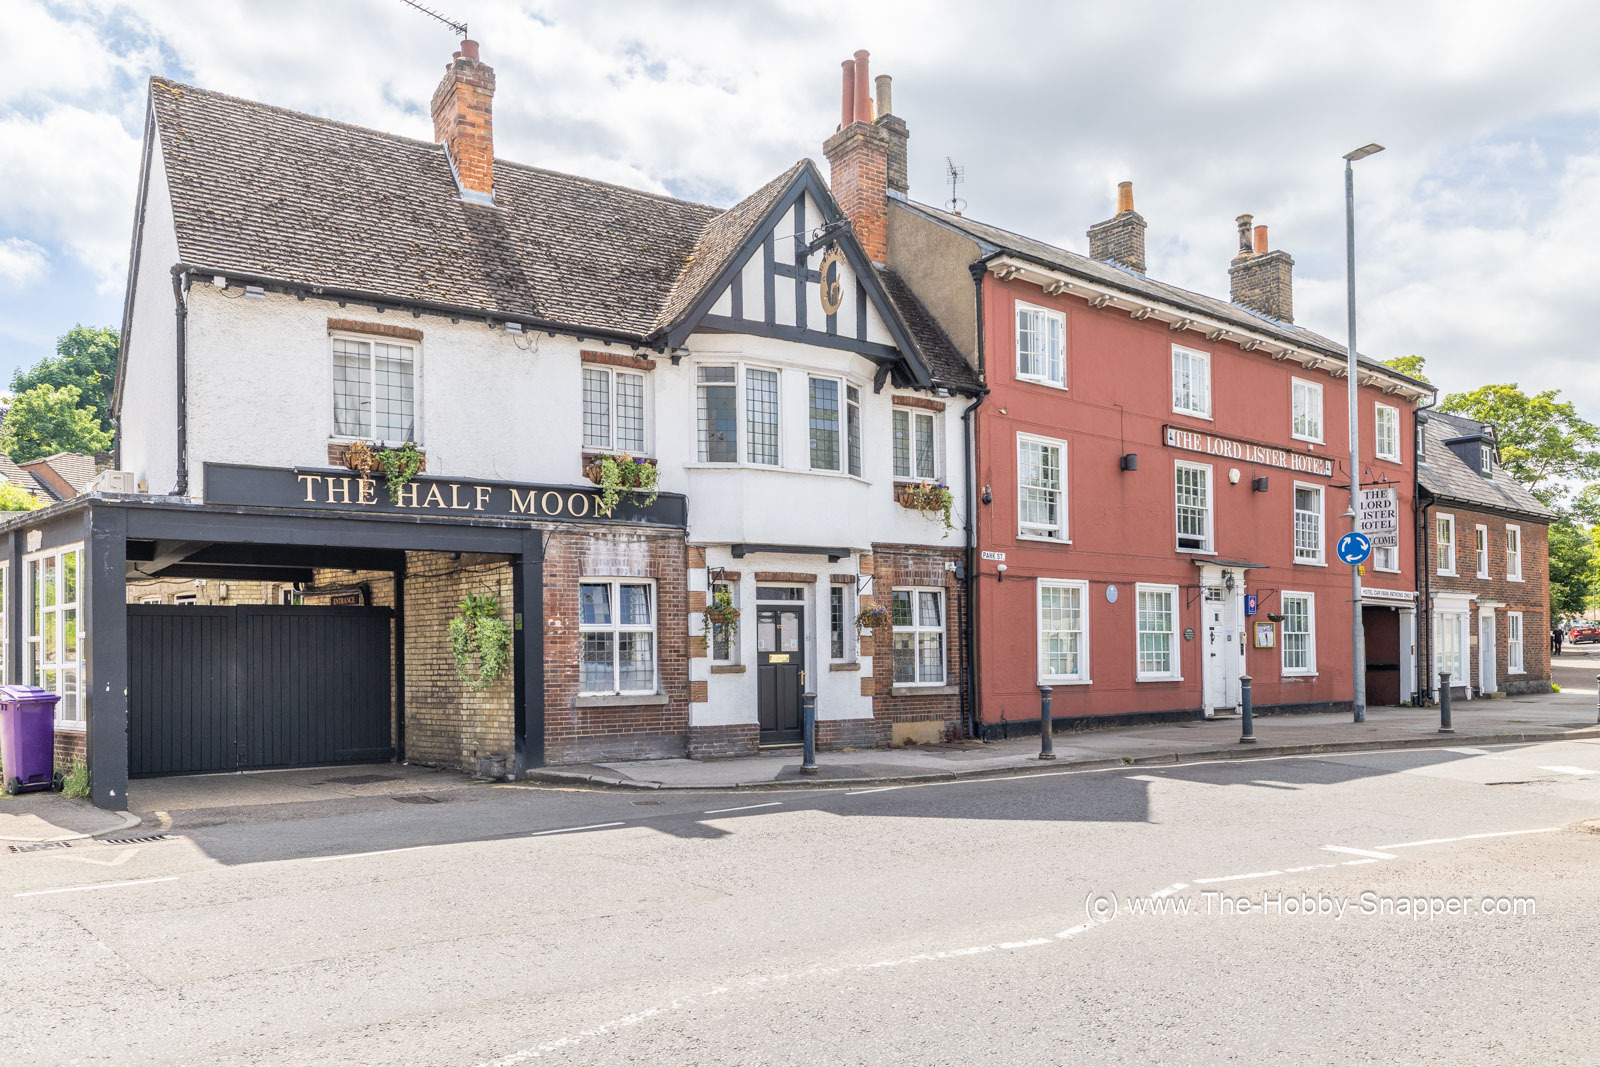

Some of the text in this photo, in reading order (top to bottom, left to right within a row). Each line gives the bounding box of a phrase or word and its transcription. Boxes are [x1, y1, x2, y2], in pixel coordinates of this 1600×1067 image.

[1174, 430, 1326, 475] THE LORD LISTER HOTEL
[297, 474, 378, 505] THE
[394, 482, 492, 512] HALF
[1360, 499, 1392, 510] LORD
[1364, 490, 1387, 500] THE
